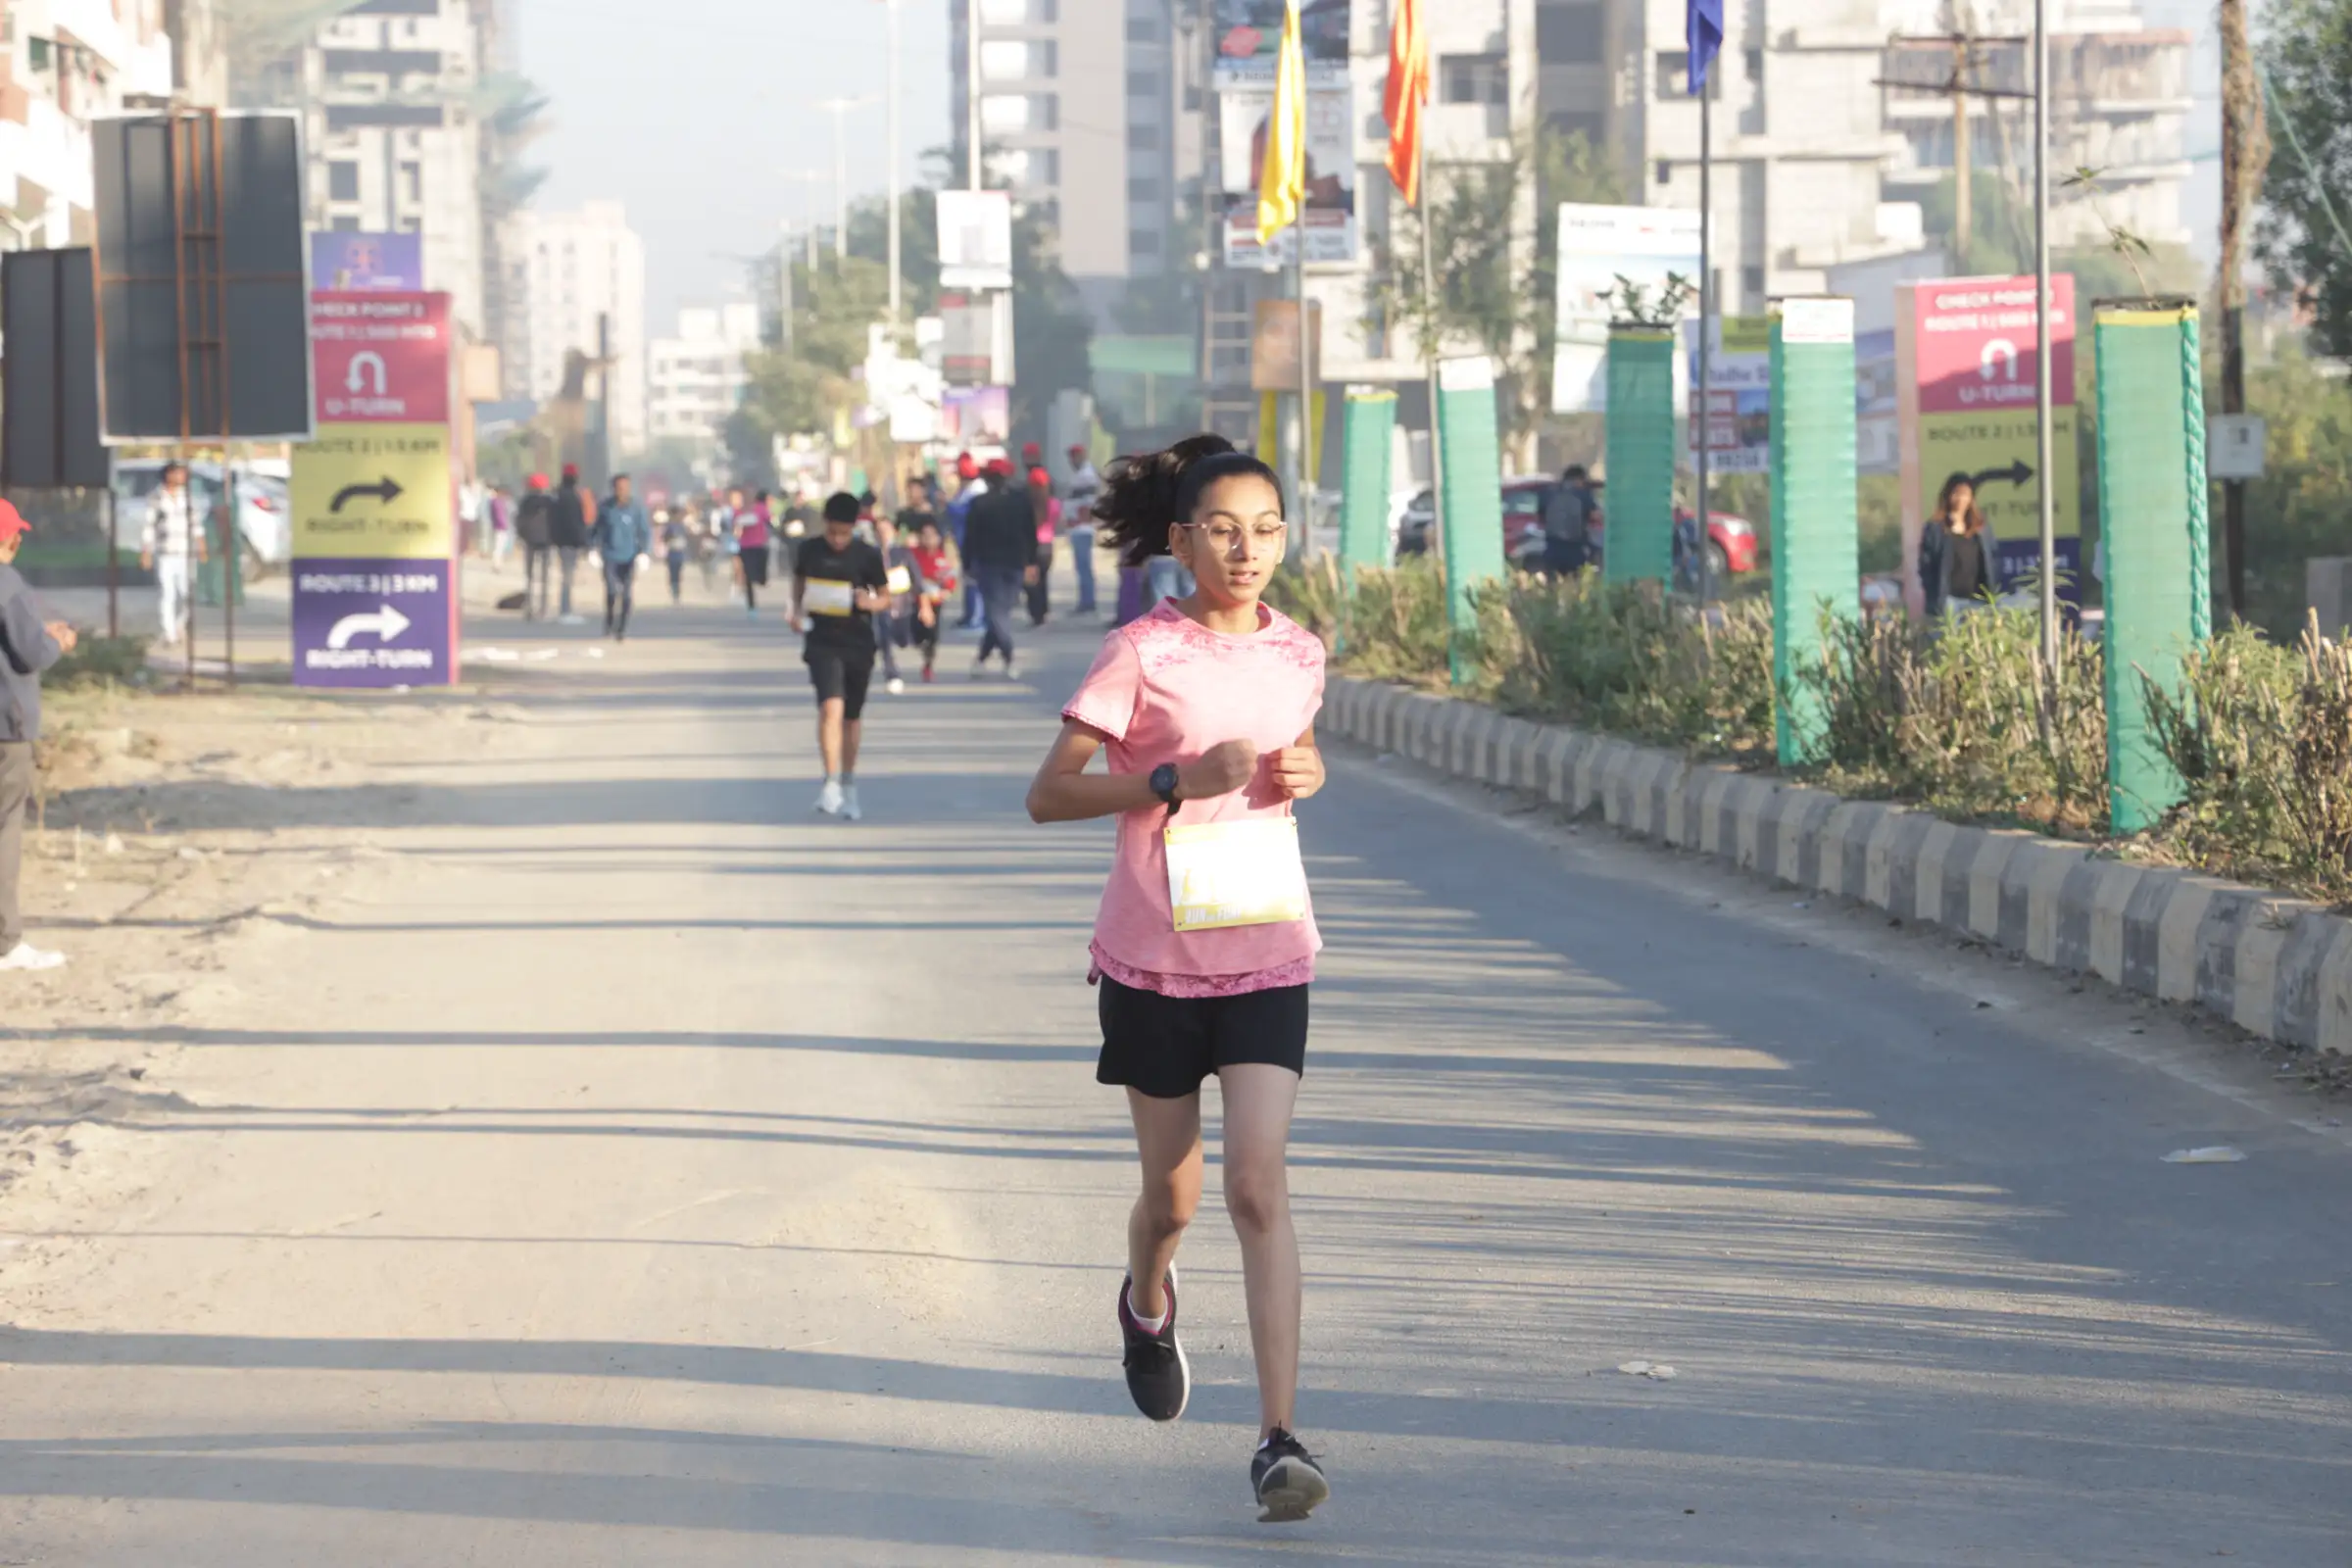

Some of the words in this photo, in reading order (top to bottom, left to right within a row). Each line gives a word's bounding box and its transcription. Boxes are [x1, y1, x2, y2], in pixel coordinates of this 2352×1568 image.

[311, 302, 359, 318] HECK
[325, 398, 406, 416] U-TURN
[299, 573, 365, 593] ROUTE
[305, 649, 433, 668] RIGHT-TURN
